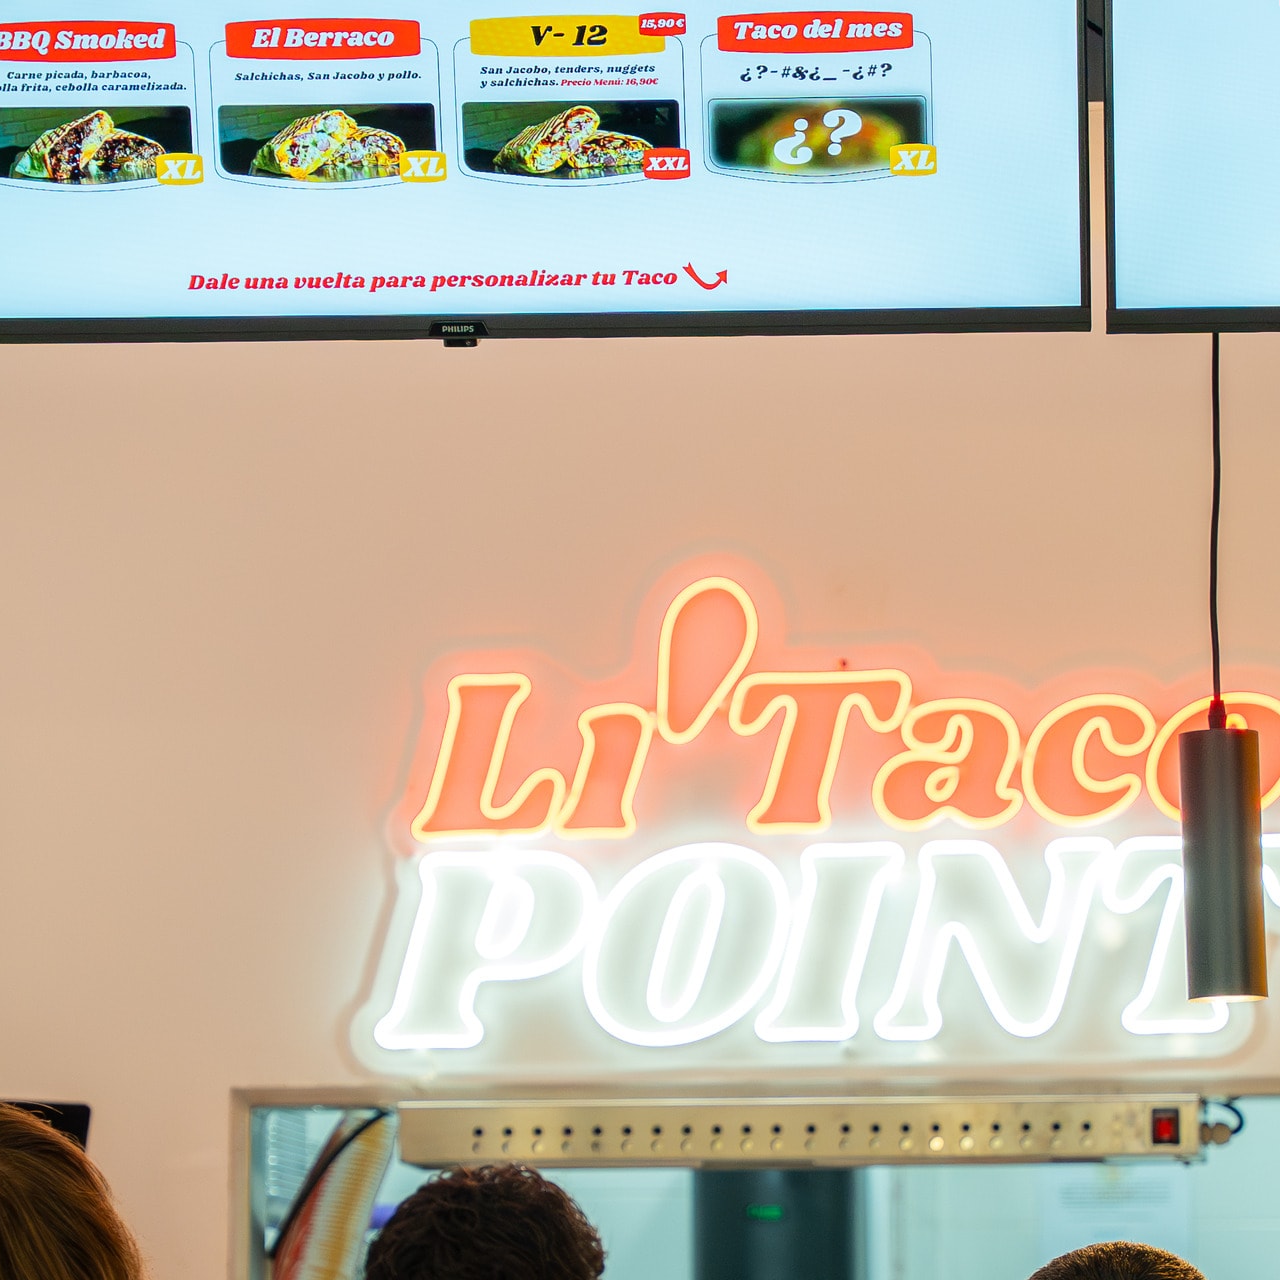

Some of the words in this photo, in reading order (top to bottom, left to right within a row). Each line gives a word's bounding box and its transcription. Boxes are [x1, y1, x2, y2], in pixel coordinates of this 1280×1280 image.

[251, 27, 281, 49] El
[284, 28, 395, 48] Berraco
[572, 25, 608, 46] 12
[733, 21, 798, 41] Taco
[803, 18, 843, 39] del
[846, 22, 903, 38] mes
[54, 28, 166, 50] Smoked
[7, 71, 42, 80] Carne
[45, 71, 88, 81] picada,
[90, 70, 152, 80] barbacoa,
[234, 72, 305, 82] Salchichas,
[307, 71, 331, 80] San
[332, 71, 375, 80] Jacobo
[376, 72, 386, 82] y
[387, 70, 422, 81] pollo.
[480, 66, 504, 75] San
[505, 65, 552, 76] Jacobo,
[554, 64, 604, 75] tenders,
[606, 64, 656, 76] nuggets
[20, 83, 52, 93] frita,
[55, 82, 99, 91] cebolla
[101, 81, 187, 91] caramelizada.
[480, 80, 488, 89] y
[490, 77, 559, 87] salchichas.
[560, 78, 592, 87] Precio
[593, 77, 624, 86] Menú:
[160, 159, 202, 179] XL
[403, 156, 445, 177] XL
[645, 156, 689, 171] XXL
[893, 150, 935, 171] XL
[187, 273, 241, 292] Dale
[244, 276, 289, 291] una
[294, 272, 366, 290] vuelta
[369, 274, 426, 293] para
[430, 269, 587, 292] personalizar
[591, 270, 616, 286] tu
[621, 268, 678, 286] Taco
[441, 324, 475, 333] PHILIPS
